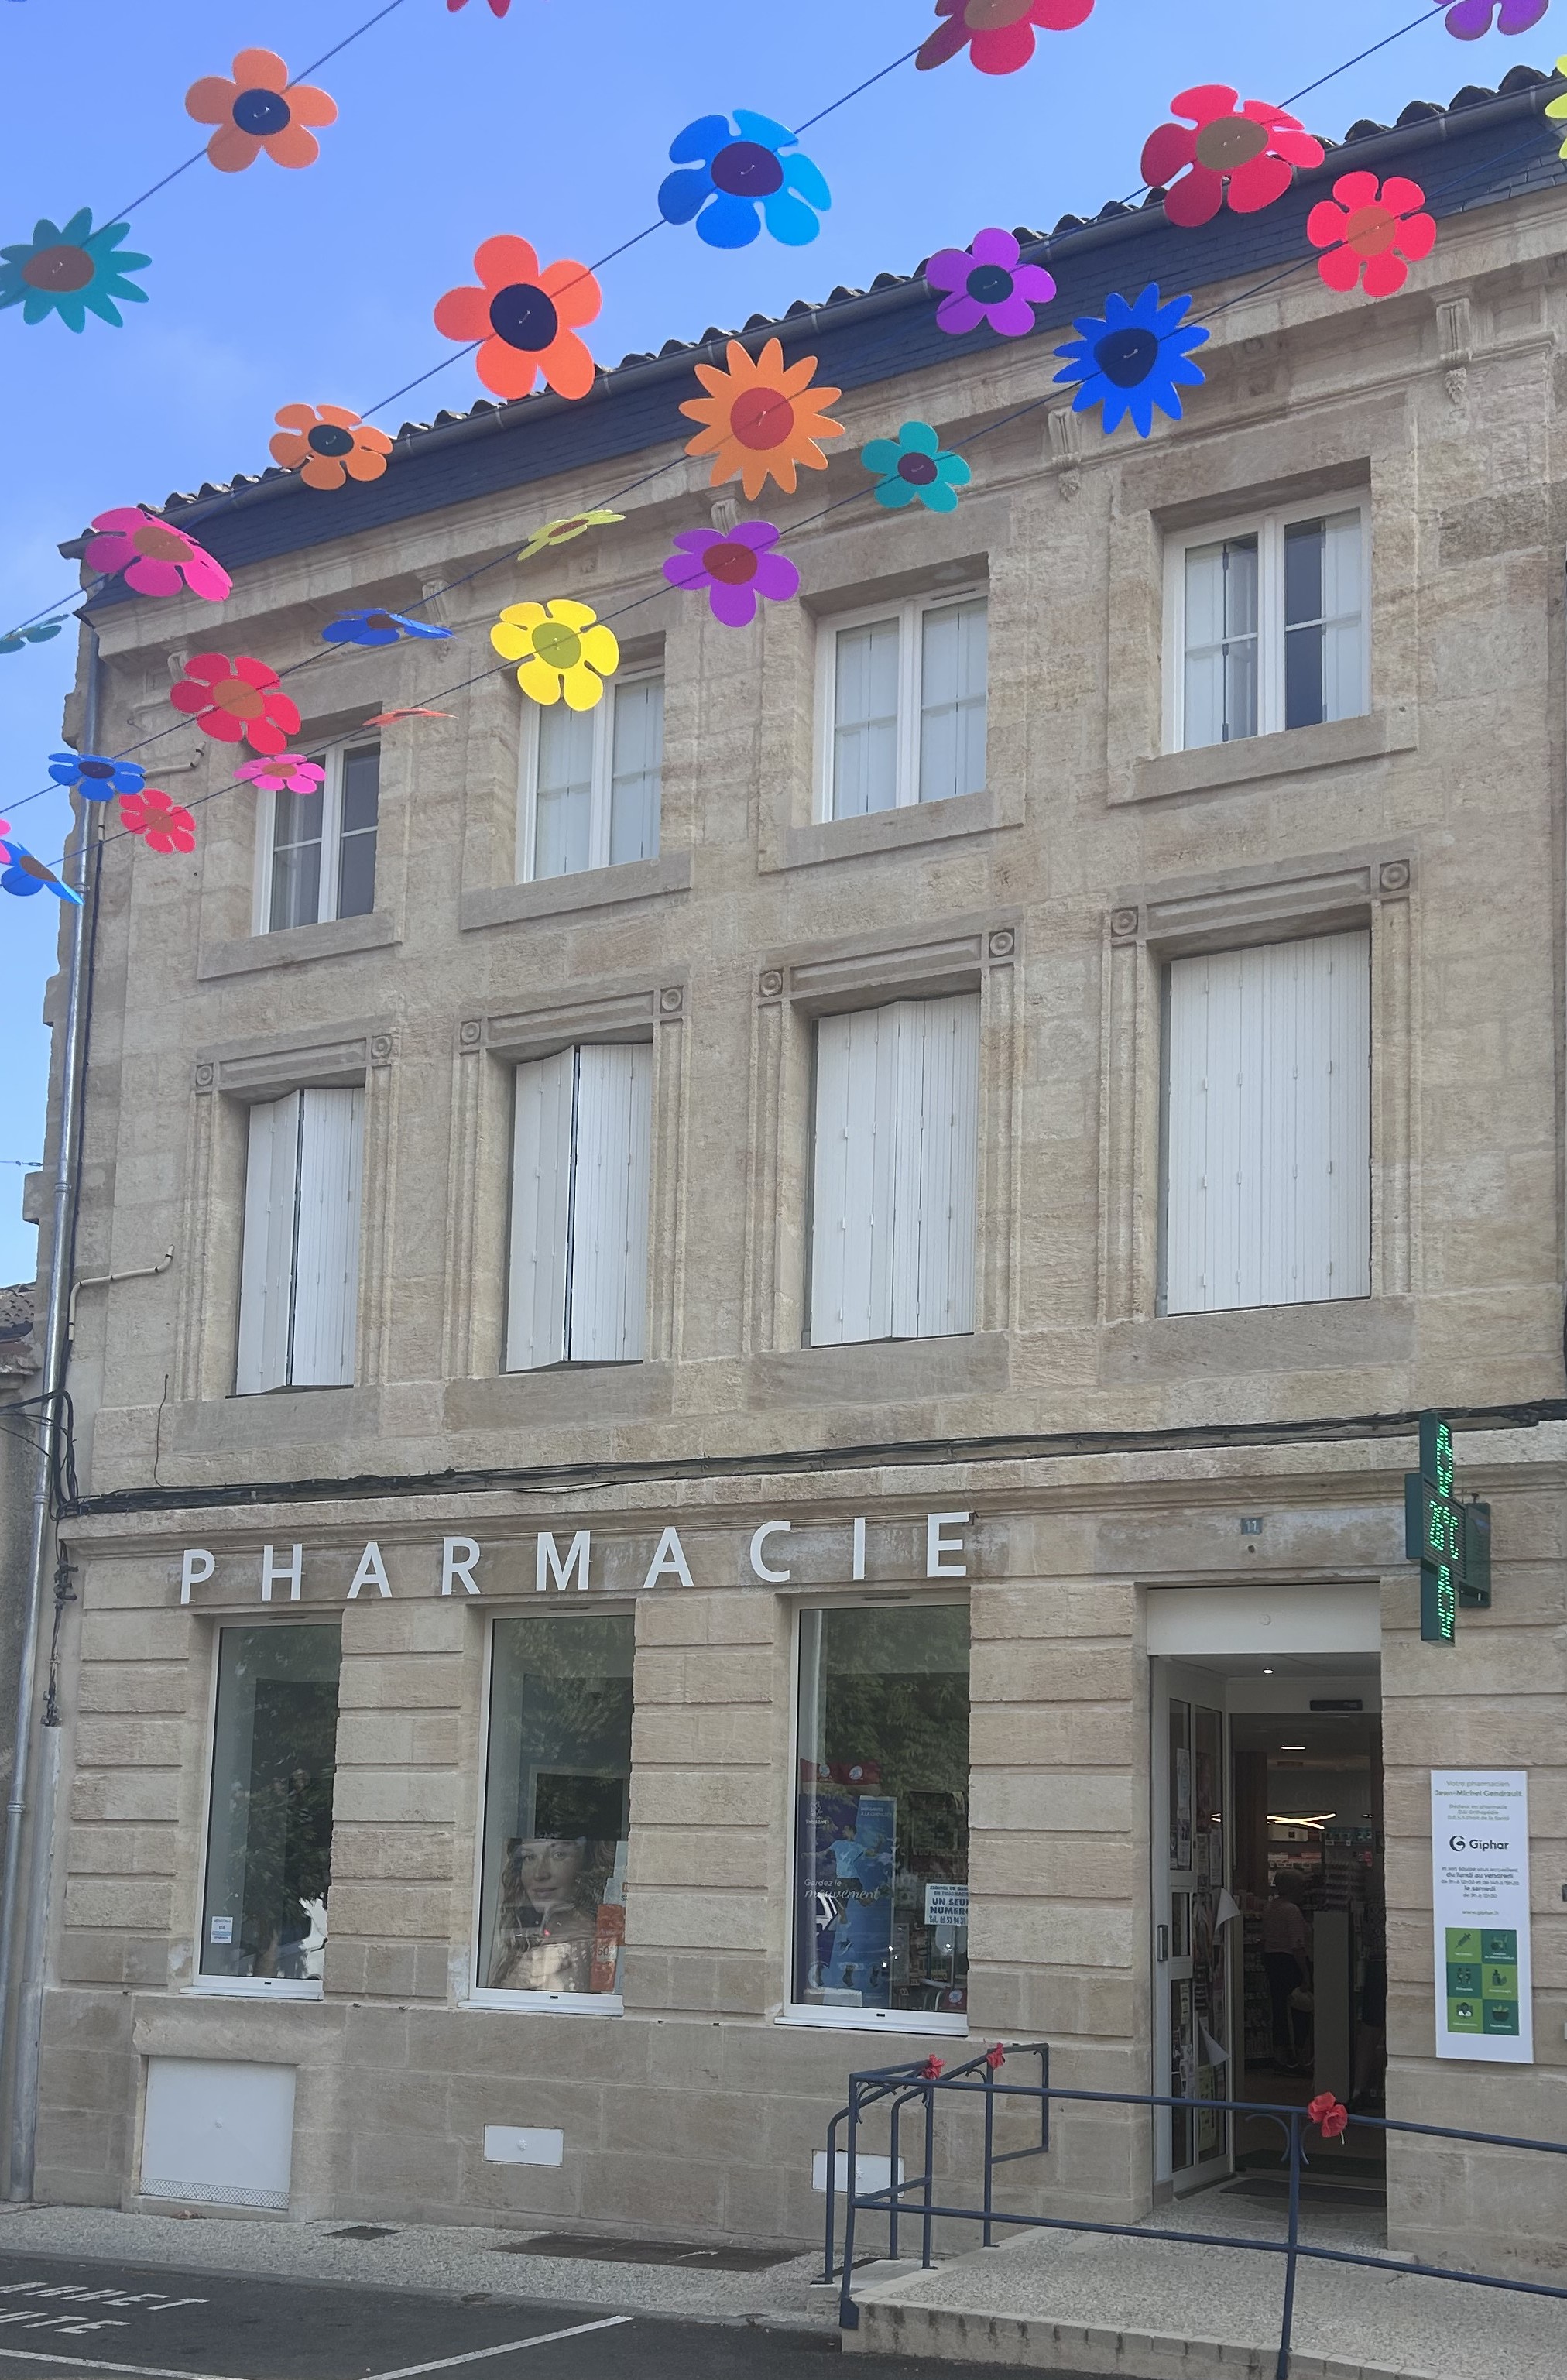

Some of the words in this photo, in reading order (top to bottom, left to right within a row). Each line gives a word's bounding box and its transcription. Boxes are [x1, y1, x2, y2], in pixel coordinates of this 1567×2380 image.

[1246, 1520, 1257, 1532] 11
[180, 1511, 969, 1604] PHARMACIE
[1469, 1839, 1510, 1852] Giphar
[804, 1878, 833, 1887] Gardez
